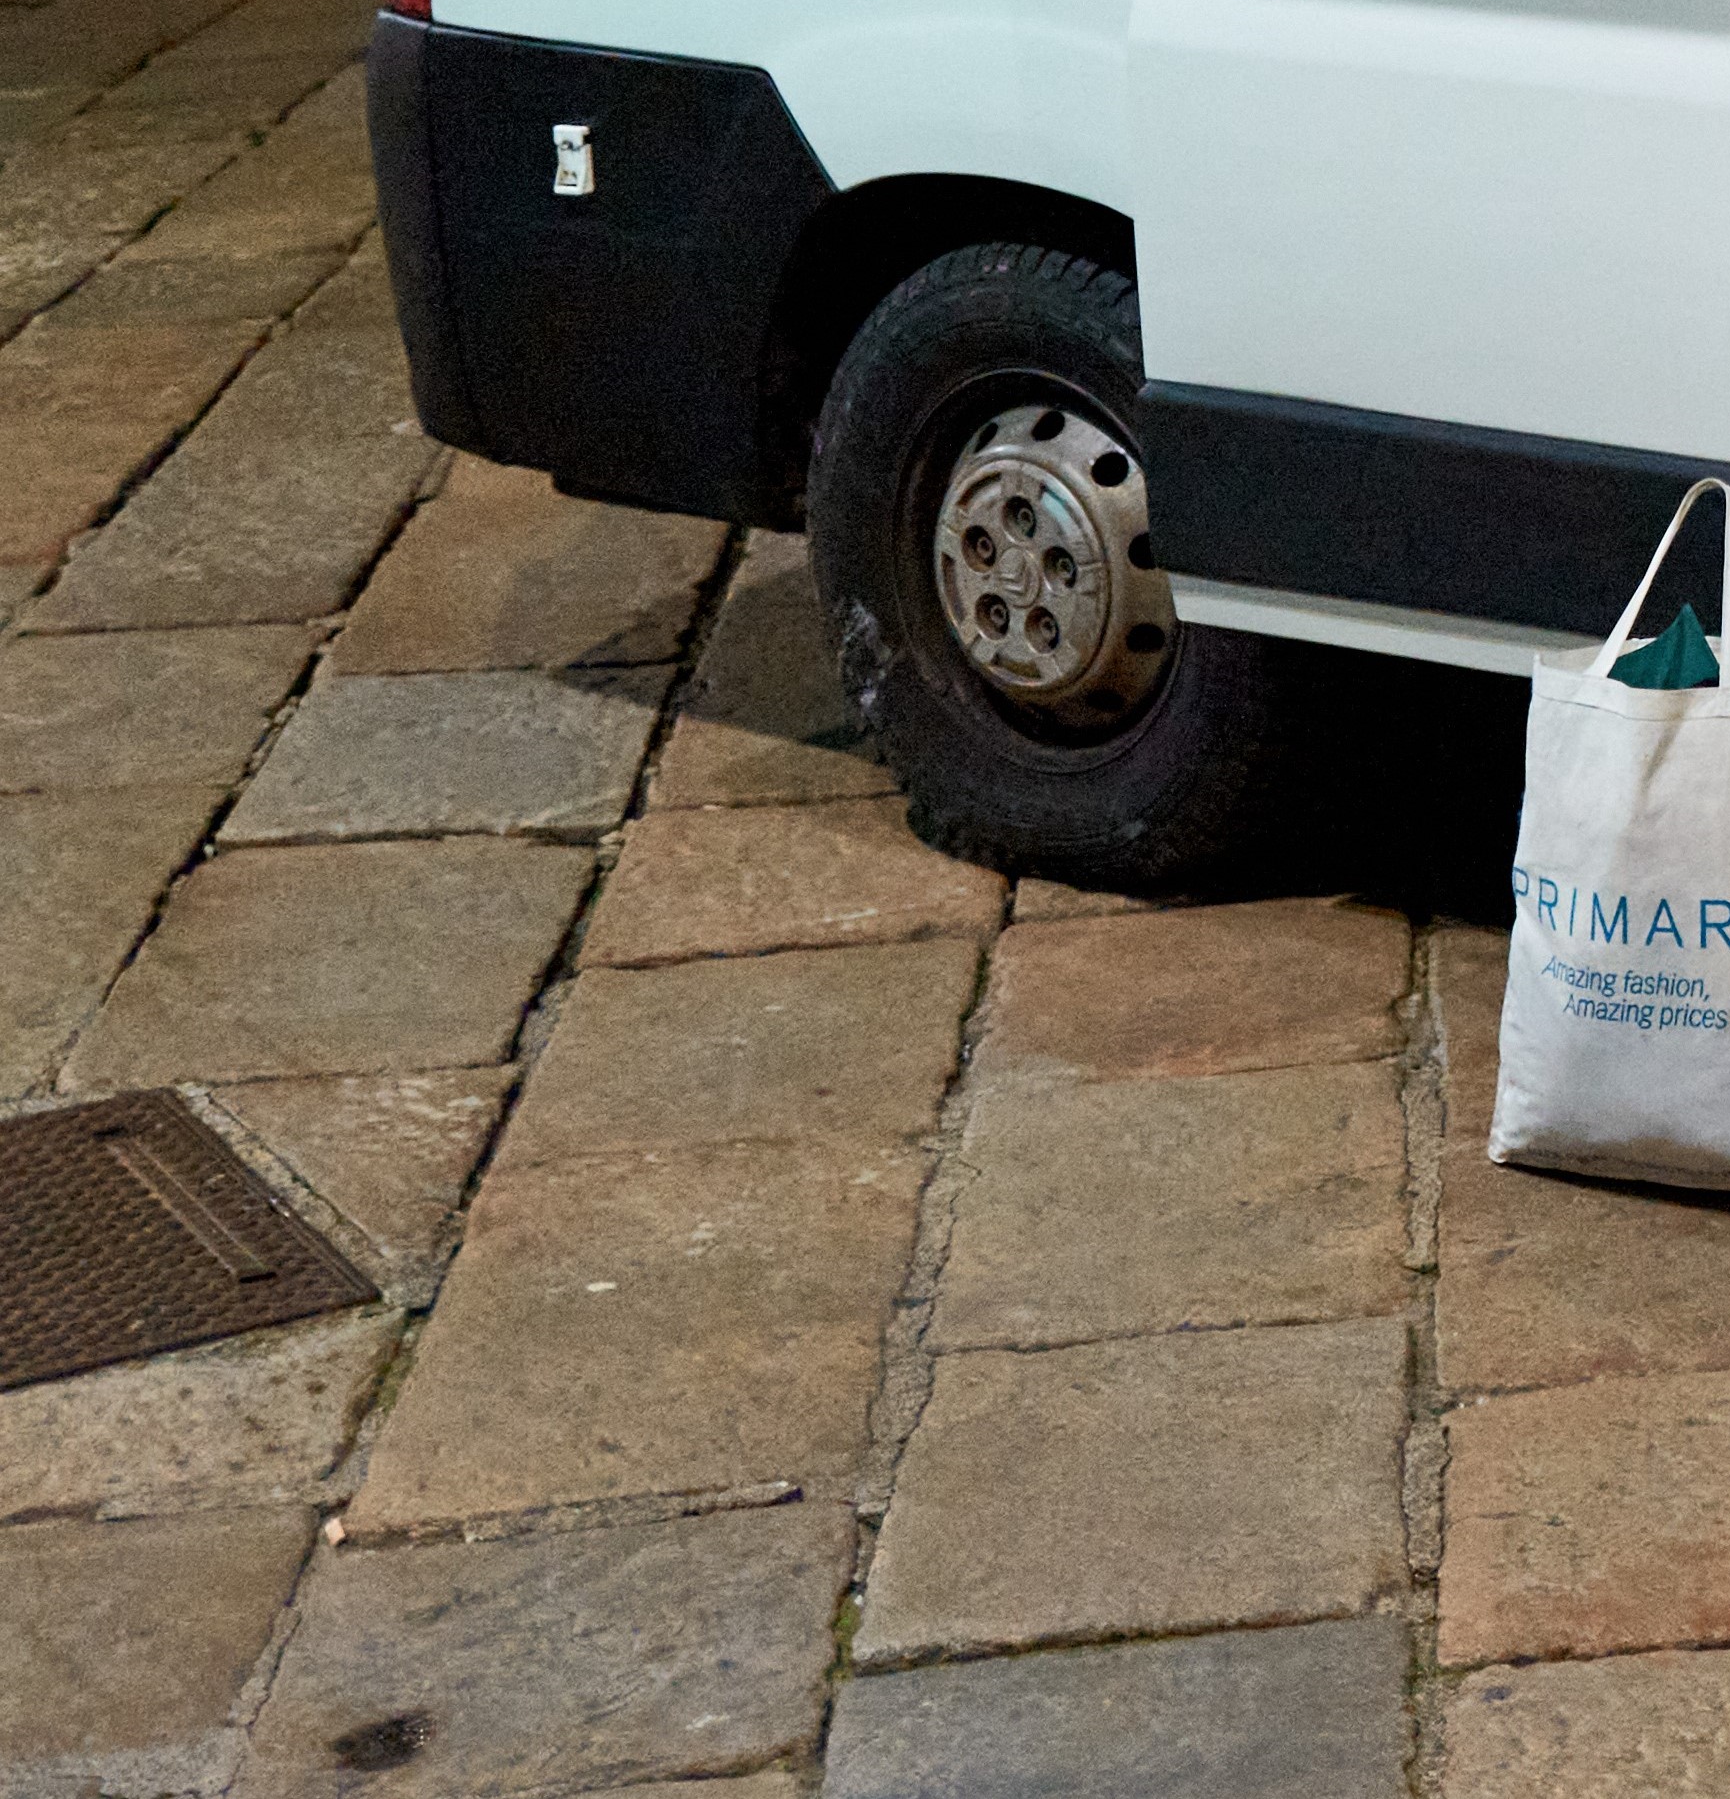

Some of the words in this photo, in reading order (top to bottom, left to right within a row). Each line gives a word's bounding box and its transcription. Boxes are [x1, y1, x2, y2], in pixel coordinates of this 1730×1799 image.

[1541, 954, 1618, 998] Amazing
[1623, 969, 1711, 1002] fashion,
[1562, 993, 1655, 1030] Amazing
[1658, 1003, 1729, 1031] prices
